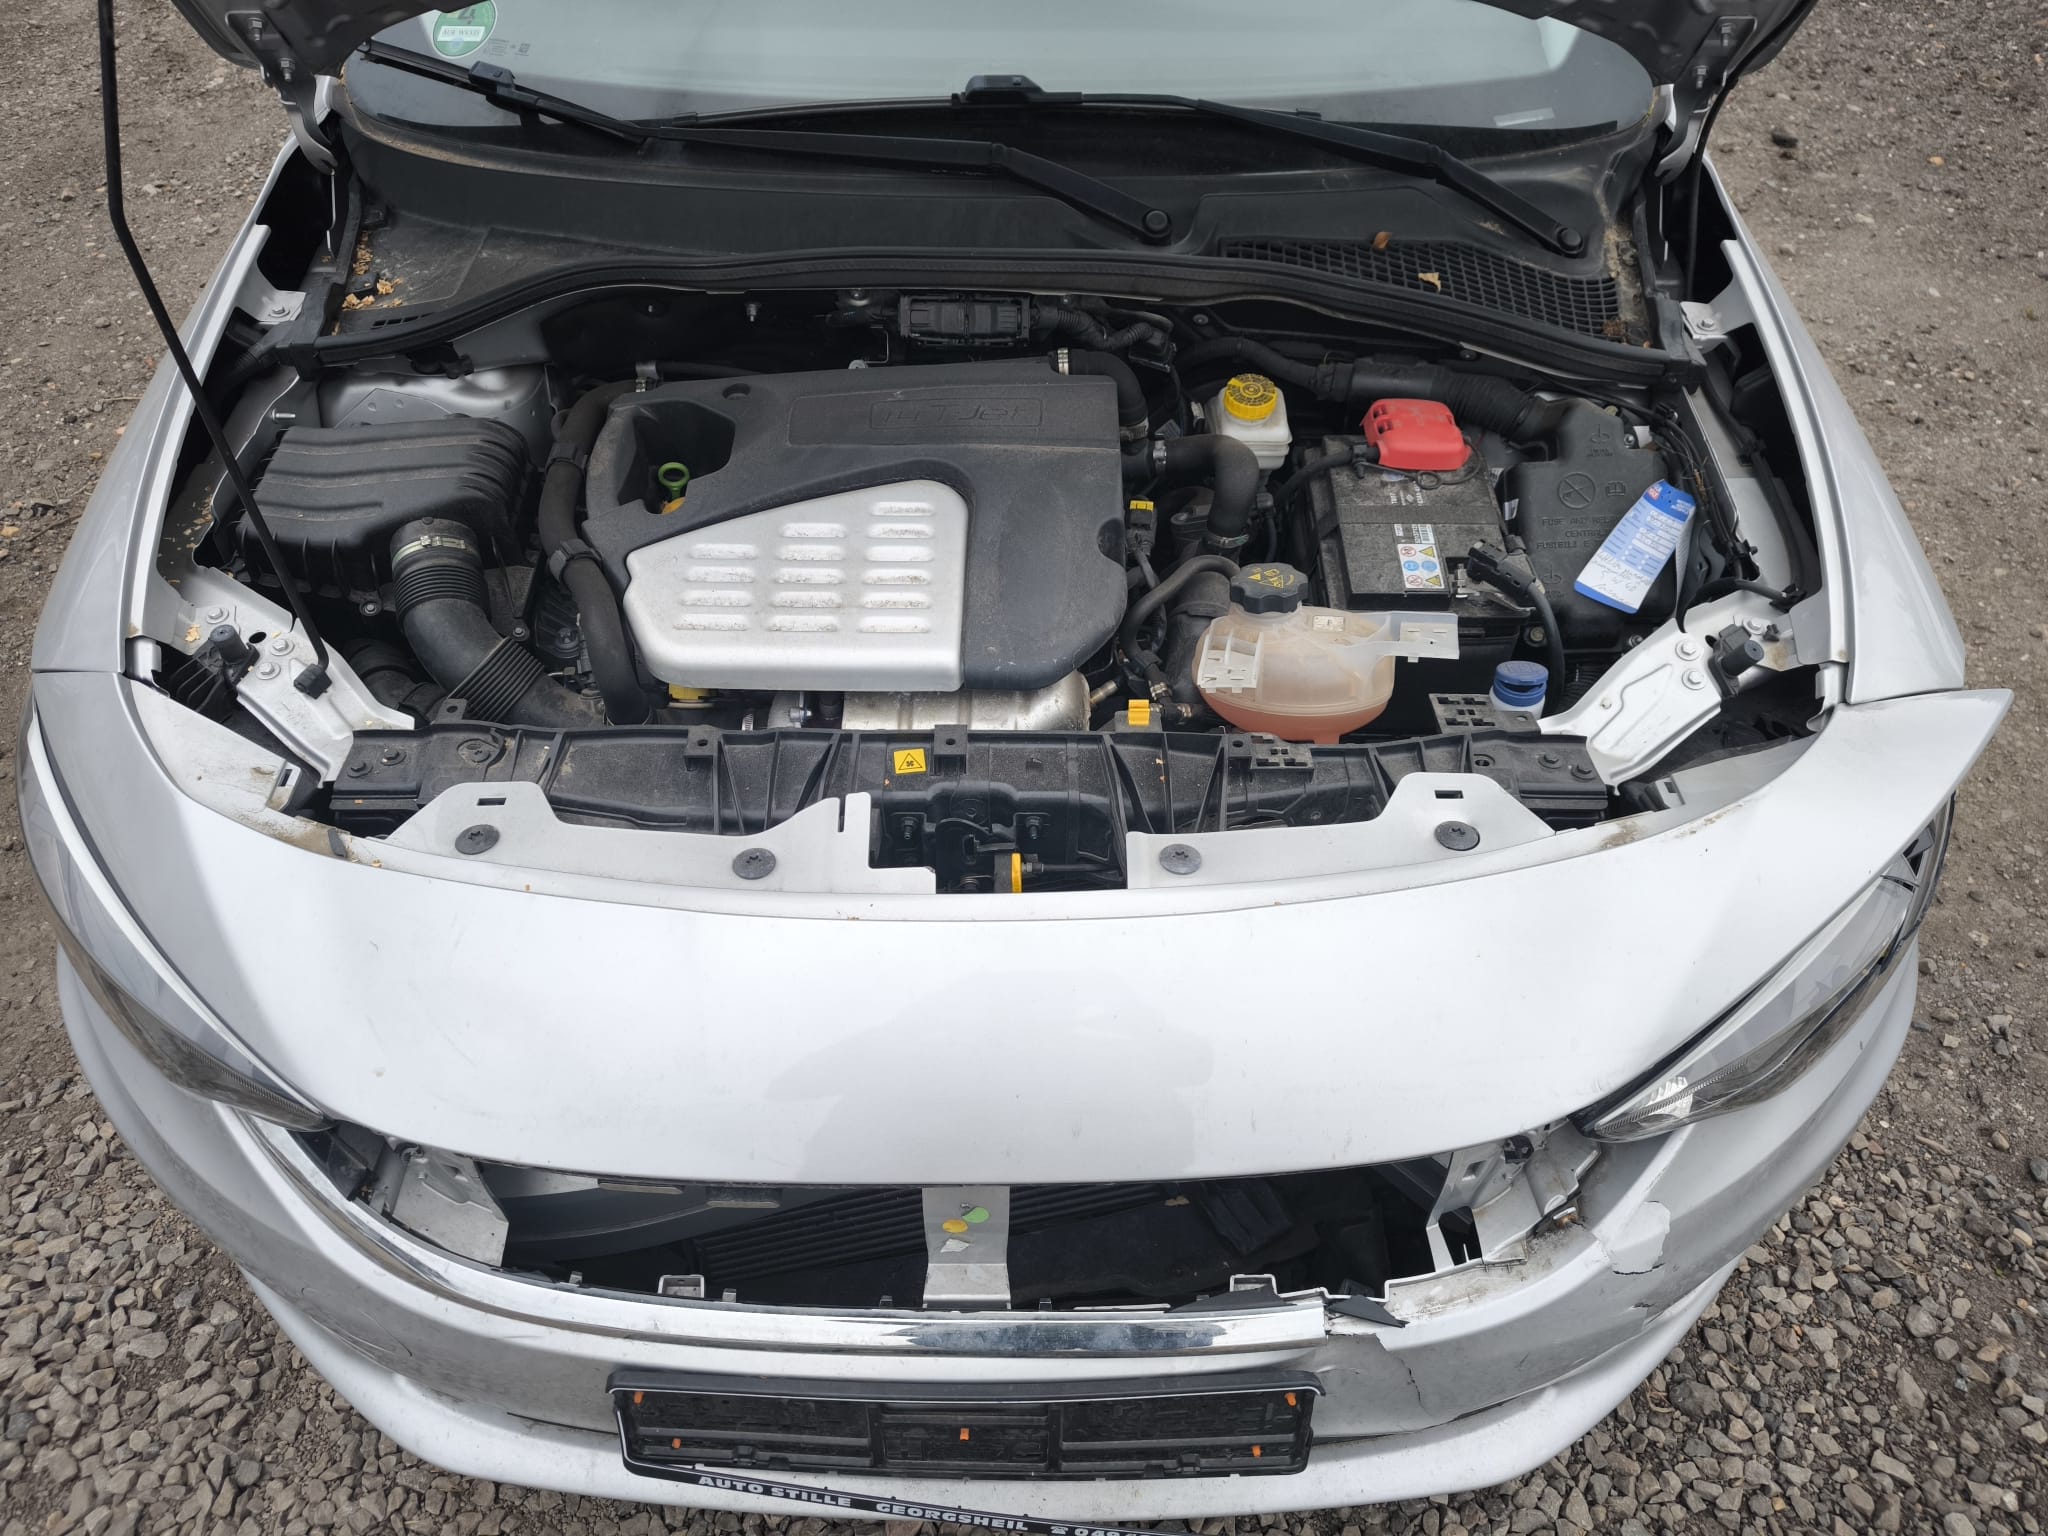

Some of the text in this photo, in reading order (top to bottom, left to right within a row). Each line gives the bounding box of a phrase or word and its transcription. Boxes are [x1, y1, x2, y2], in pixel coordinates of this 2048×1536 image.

[699, 1476, 764, 1494] AUTO
[770, 1487, 850, 1507] STILLE
[876, 1503, 1029, 1531] GEORGSHEIL
